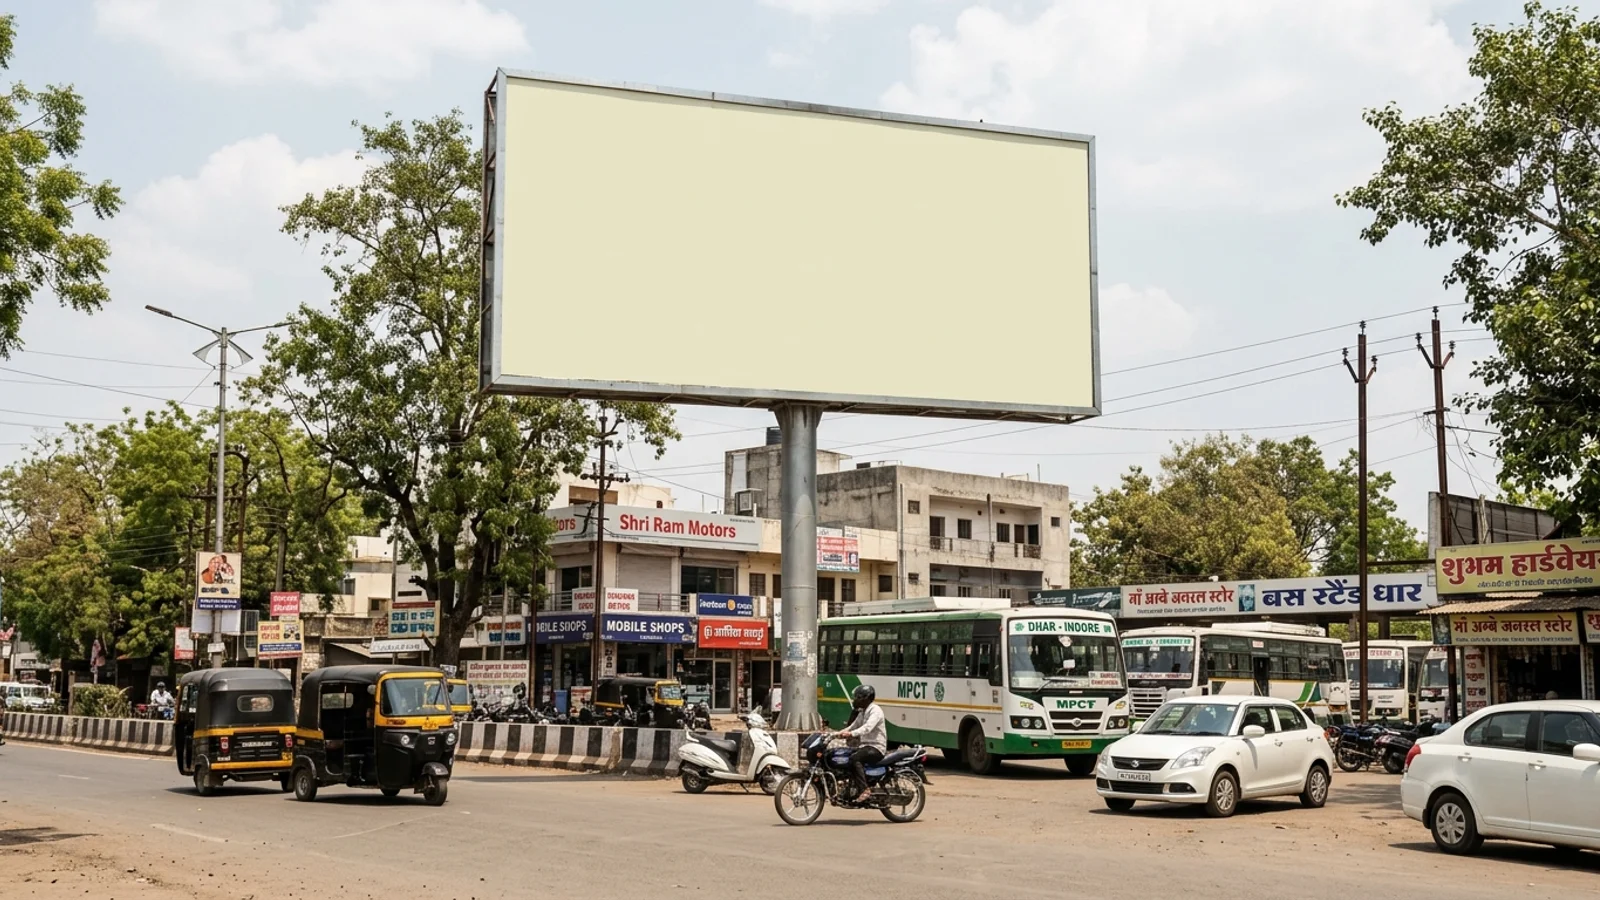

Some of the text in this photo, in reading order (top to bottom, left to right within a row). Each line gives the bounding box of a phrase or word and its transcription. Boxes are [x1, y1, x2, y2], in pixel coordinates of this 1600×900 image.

[620, 514, 649, 532] Shri
[654, 517, 684, 534] Ram
[688, 520, 736, 538] Motors
[1441, 544, 1600, 585] शुभम हार्डवेय
[1209, 585, 1234, 603] स्टोर
[1262, 579, 1422, 607] बस स्टैंड धार
[606, 620, 685, 634] MOBILE SHOPS
[1028, 621, 1056, 632] DHAR
[1544, 615, 1573, 633] स्टोर
[897, 681, 928, 699] MPCT
